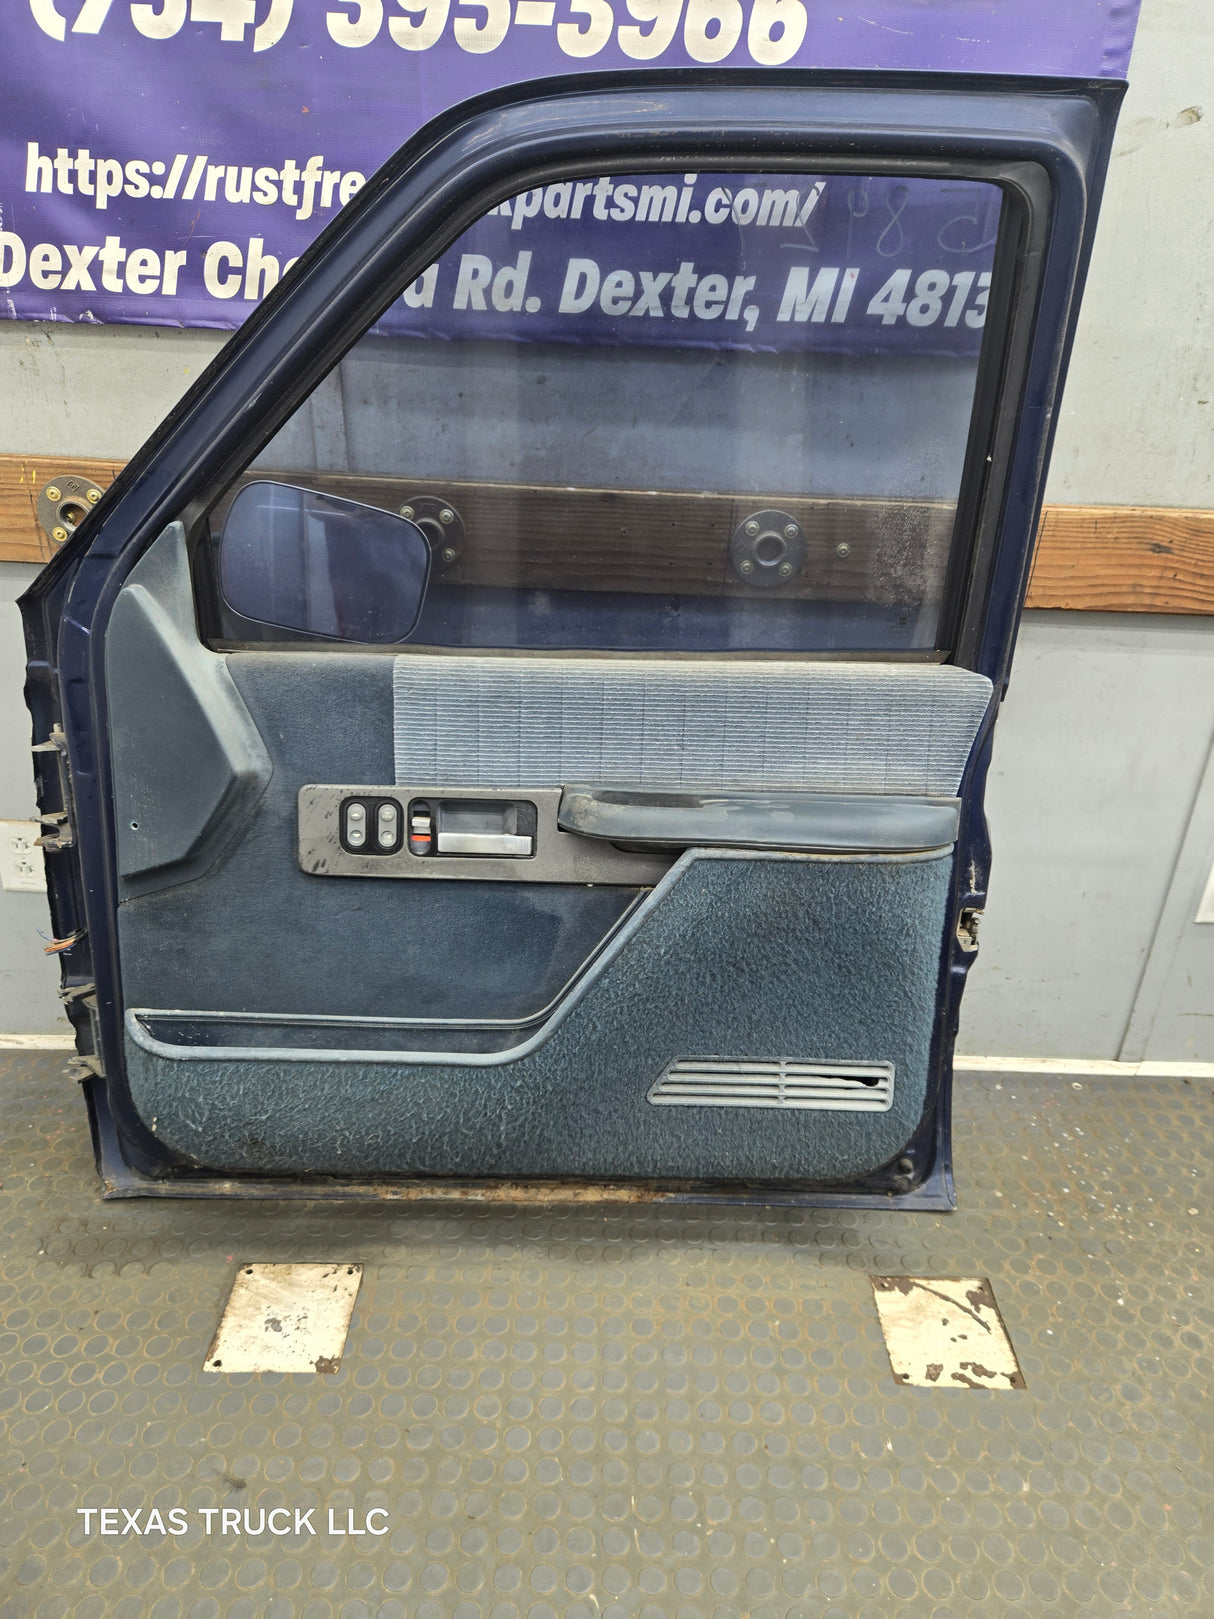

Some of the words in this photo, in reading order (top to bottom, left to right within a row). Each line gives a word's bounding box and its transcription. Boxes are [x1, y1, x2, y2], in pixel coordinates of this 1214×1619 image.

[25, 141, 366, 220] https://rustfre
[0, 231, 187, 296] Dexter
[453, 251, 541, 313] Rd.
[558, 258, 760, 331] Dexter,
[776, 267, 860, 323] MI
